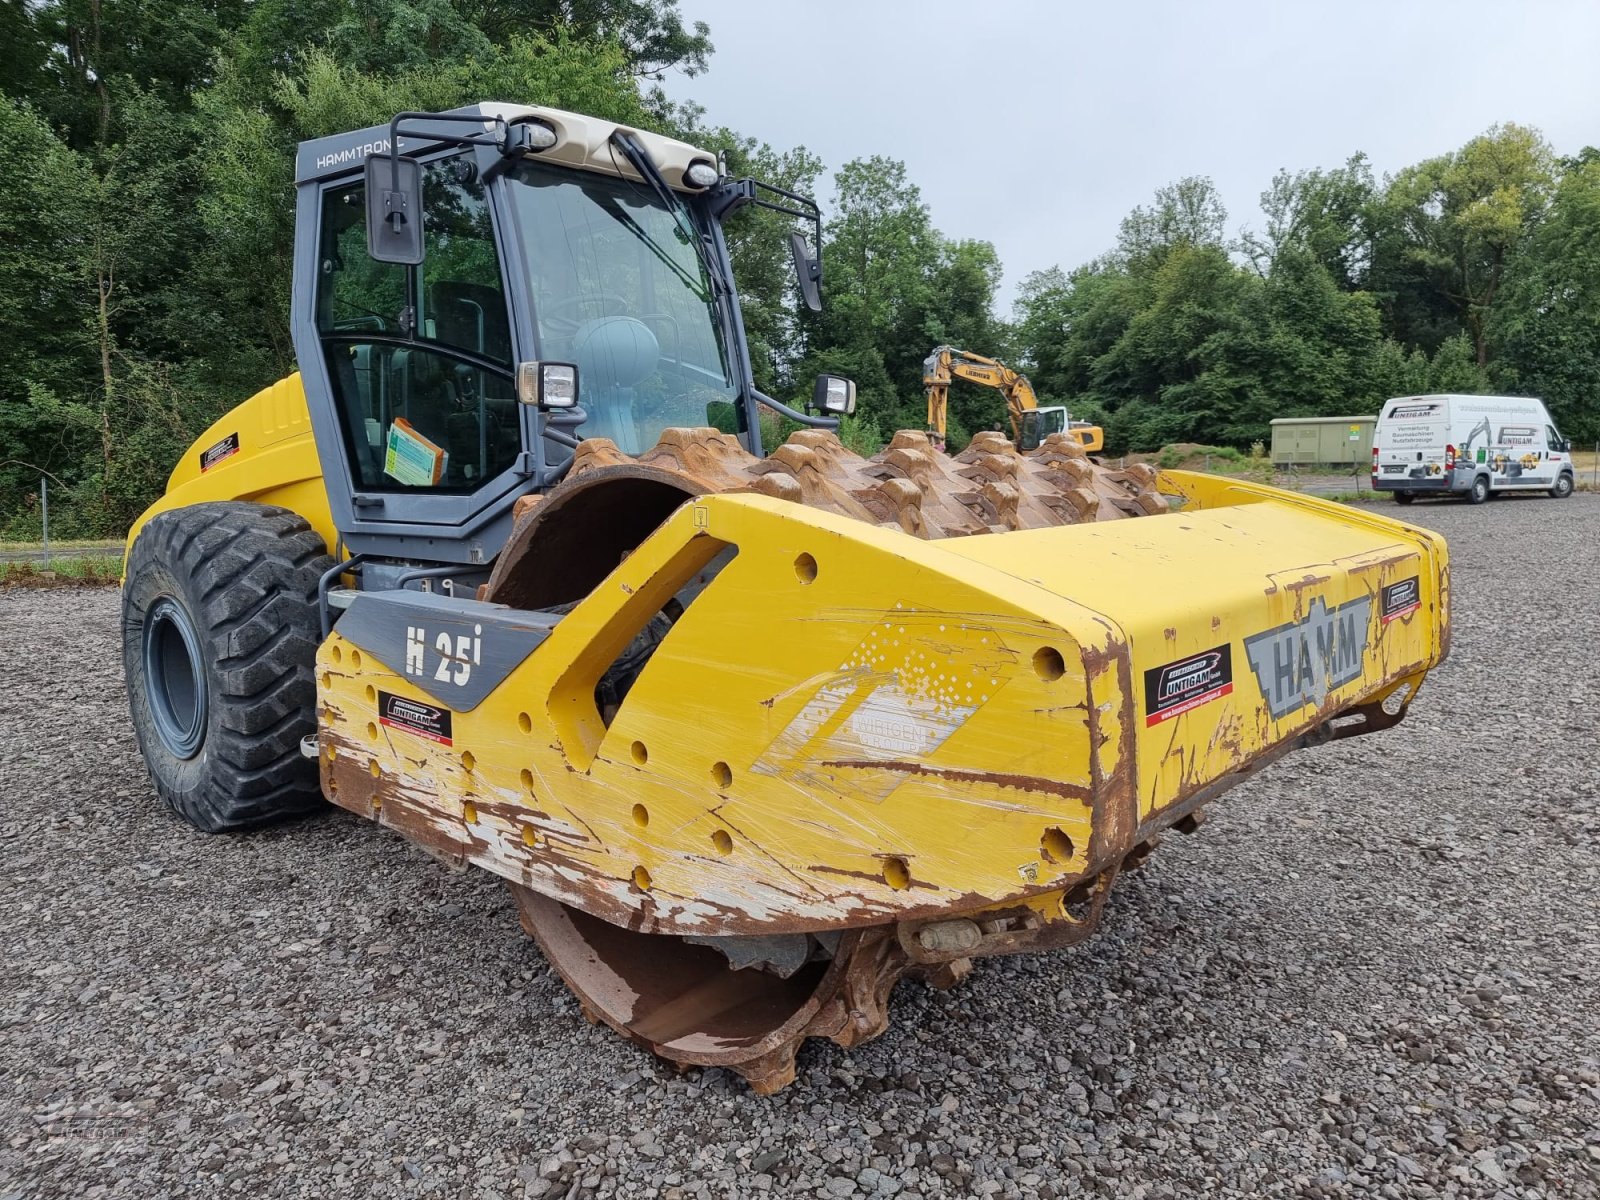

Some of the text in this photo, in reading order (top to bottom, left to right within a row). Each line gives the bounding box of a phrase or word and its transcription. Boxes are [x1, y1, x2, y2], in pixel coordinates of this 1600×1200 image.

[316, 136, 405, 168] HAMMTRONC
[966, 370, 990, 379] LIEBHERR
[406, 623, 482, 687] H 25i
[1273, 612, 1358, 704] HAMM
